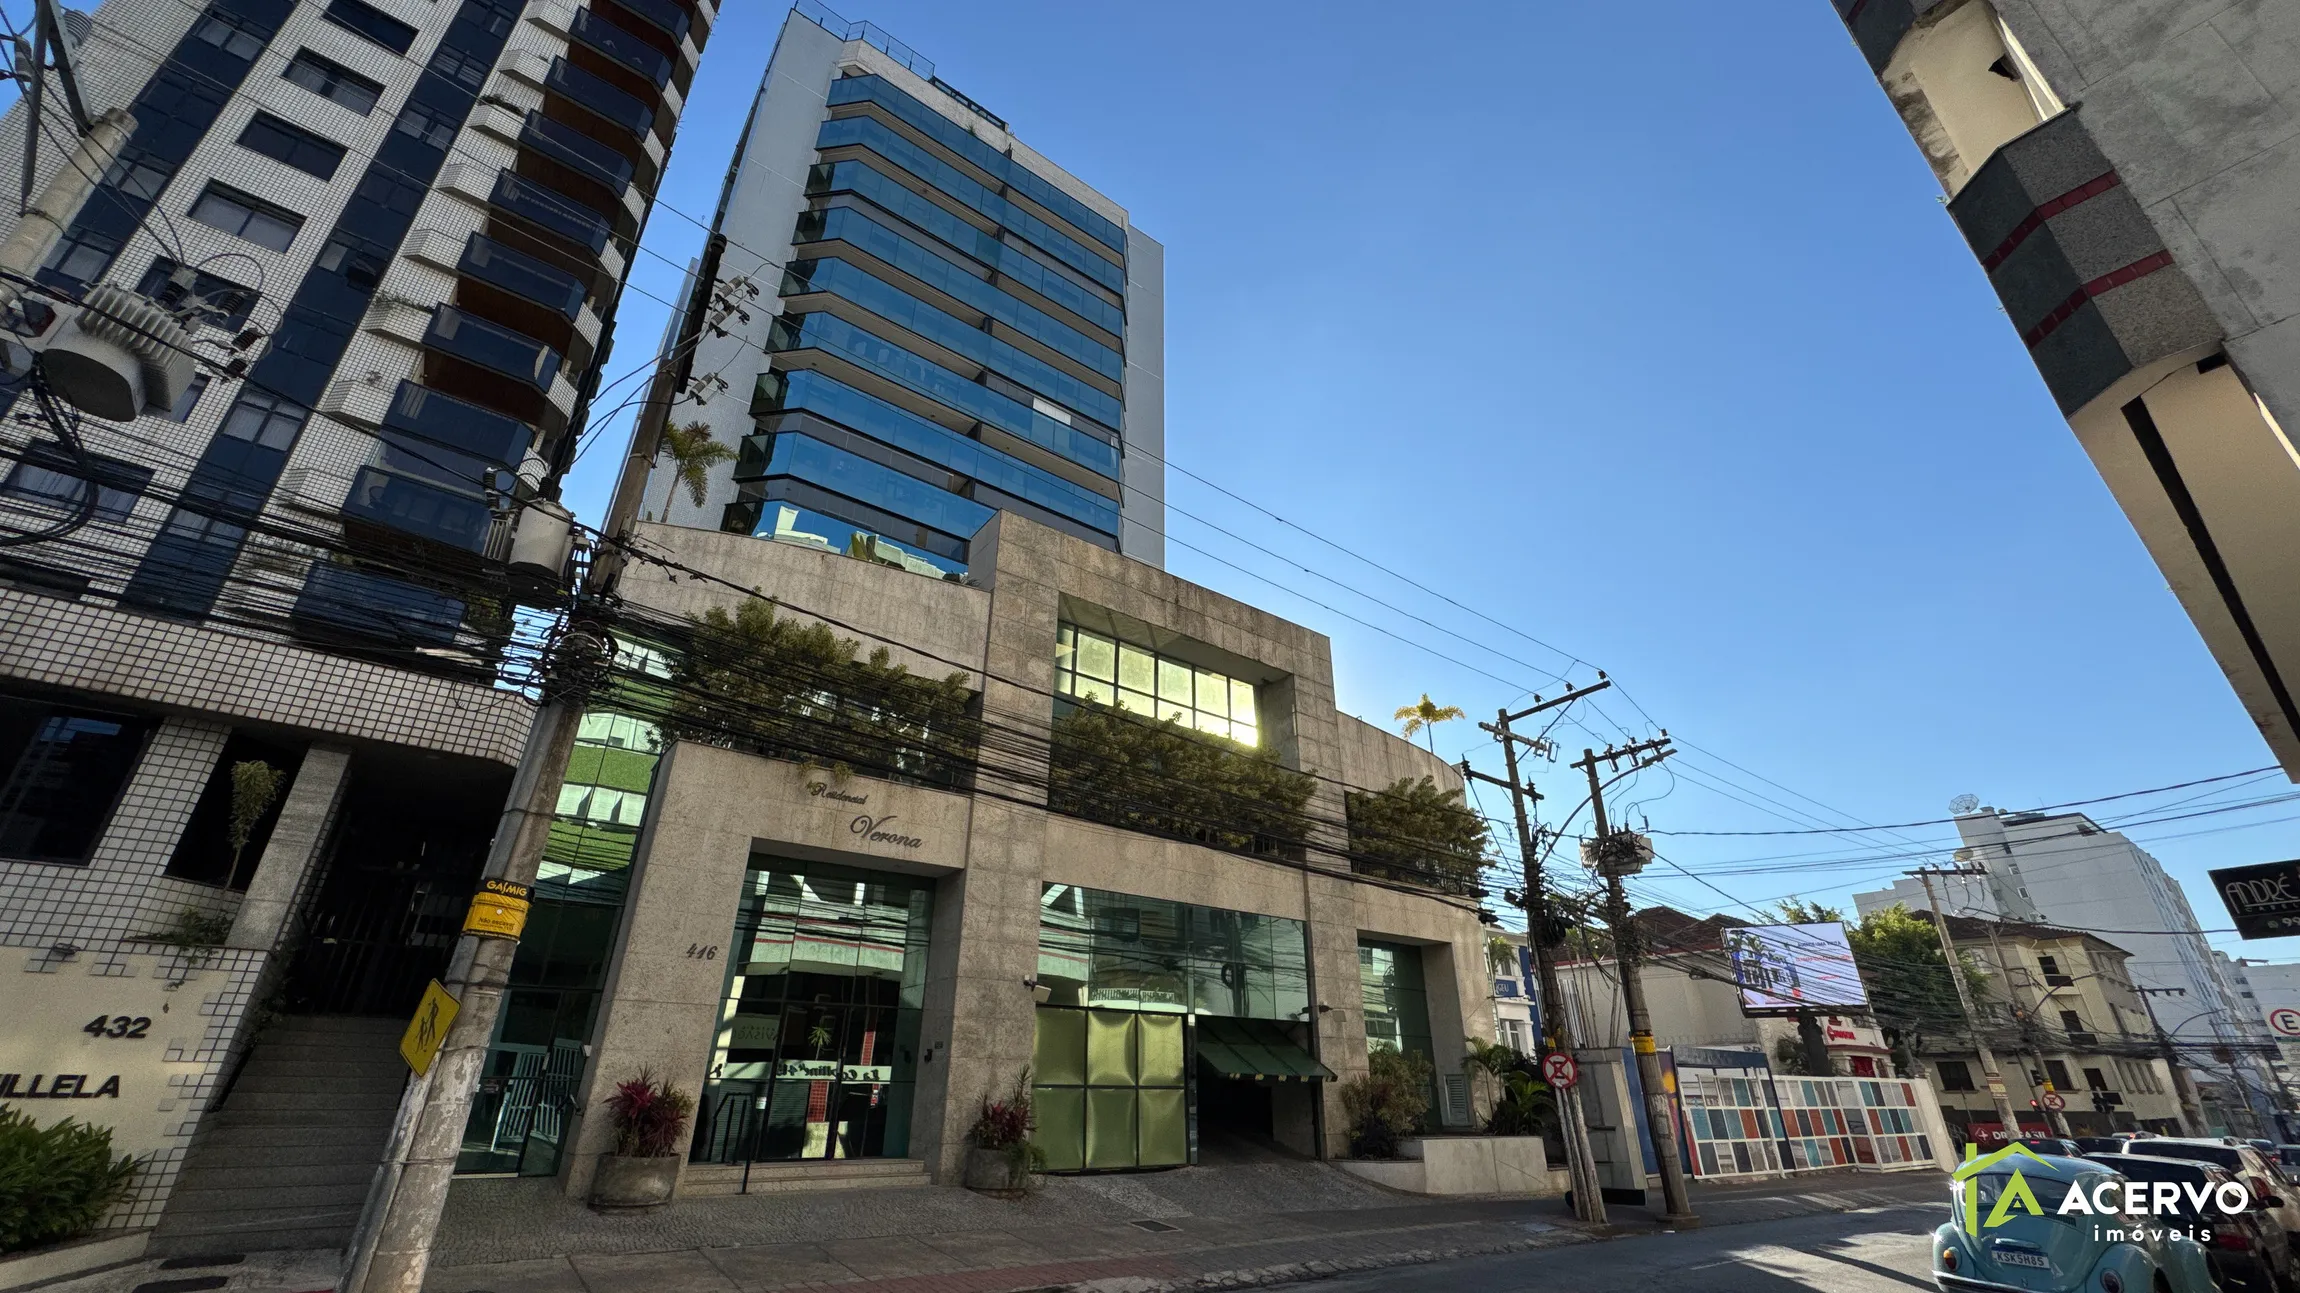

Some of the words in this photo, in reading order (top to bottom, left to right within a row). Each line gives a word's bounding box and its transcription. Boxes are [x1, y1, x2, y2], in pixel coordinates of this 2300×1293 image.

[850, 815, 922, 848] Verona
[486, 880, 527, 896] GASMIG
[2225, 872, 2299, 914] ANDRÉ
[686, 943, 718, 961] 416
[83, 1014, 152, 1039] 432
[2280, 1014, 2299, 1030] E
[1996, 1252, 2045, 1267] KSK5H85
